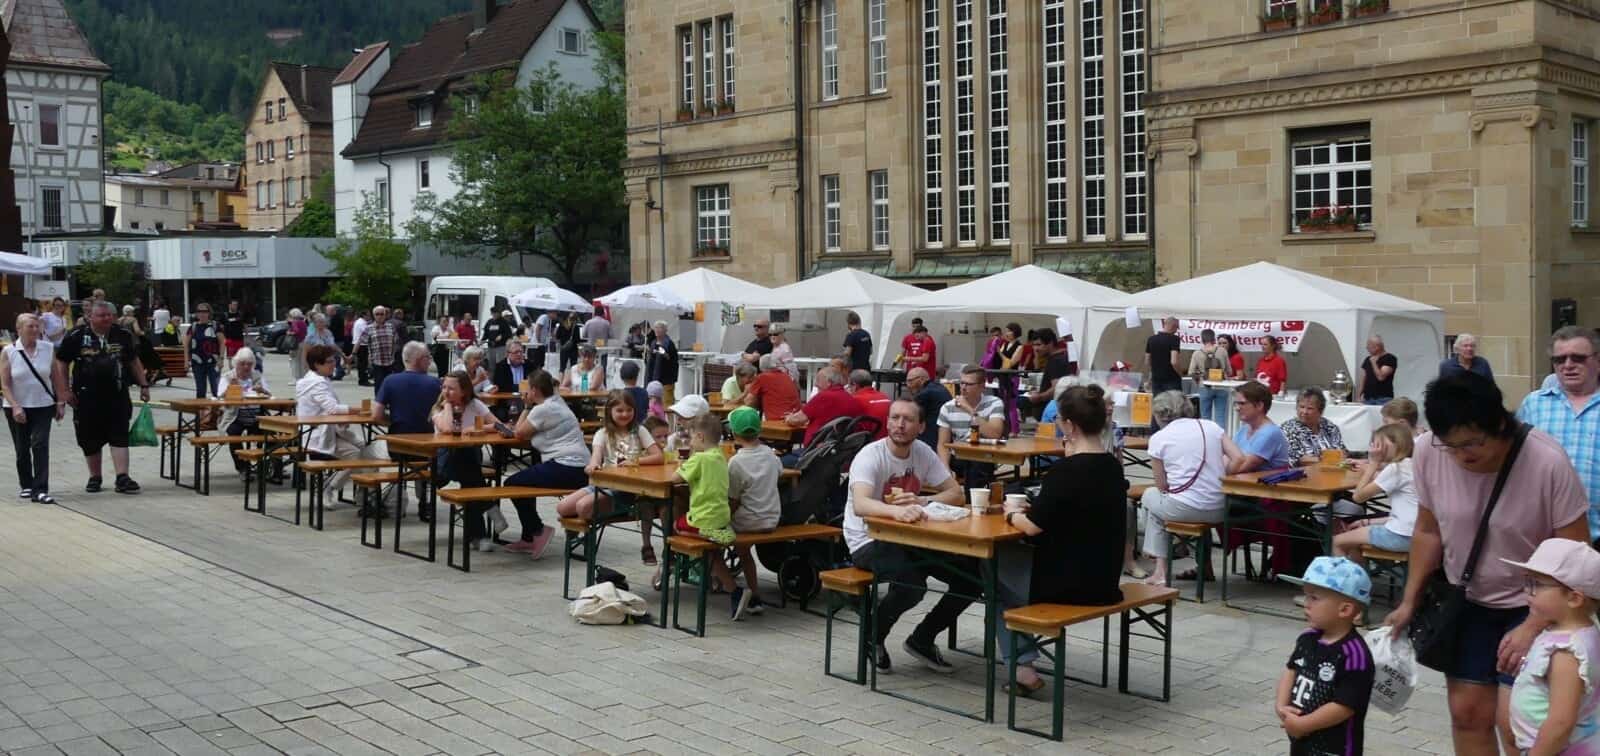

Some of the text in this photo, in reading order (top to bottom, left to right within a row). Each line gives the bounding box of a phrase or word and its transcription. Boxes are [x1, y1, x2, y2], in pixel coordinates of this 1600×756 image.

[1187, 320, 1272, 333] Schramberg
[1292, 675, 1315, 707] T
[1374, 682, 1397, 700] IEBE
